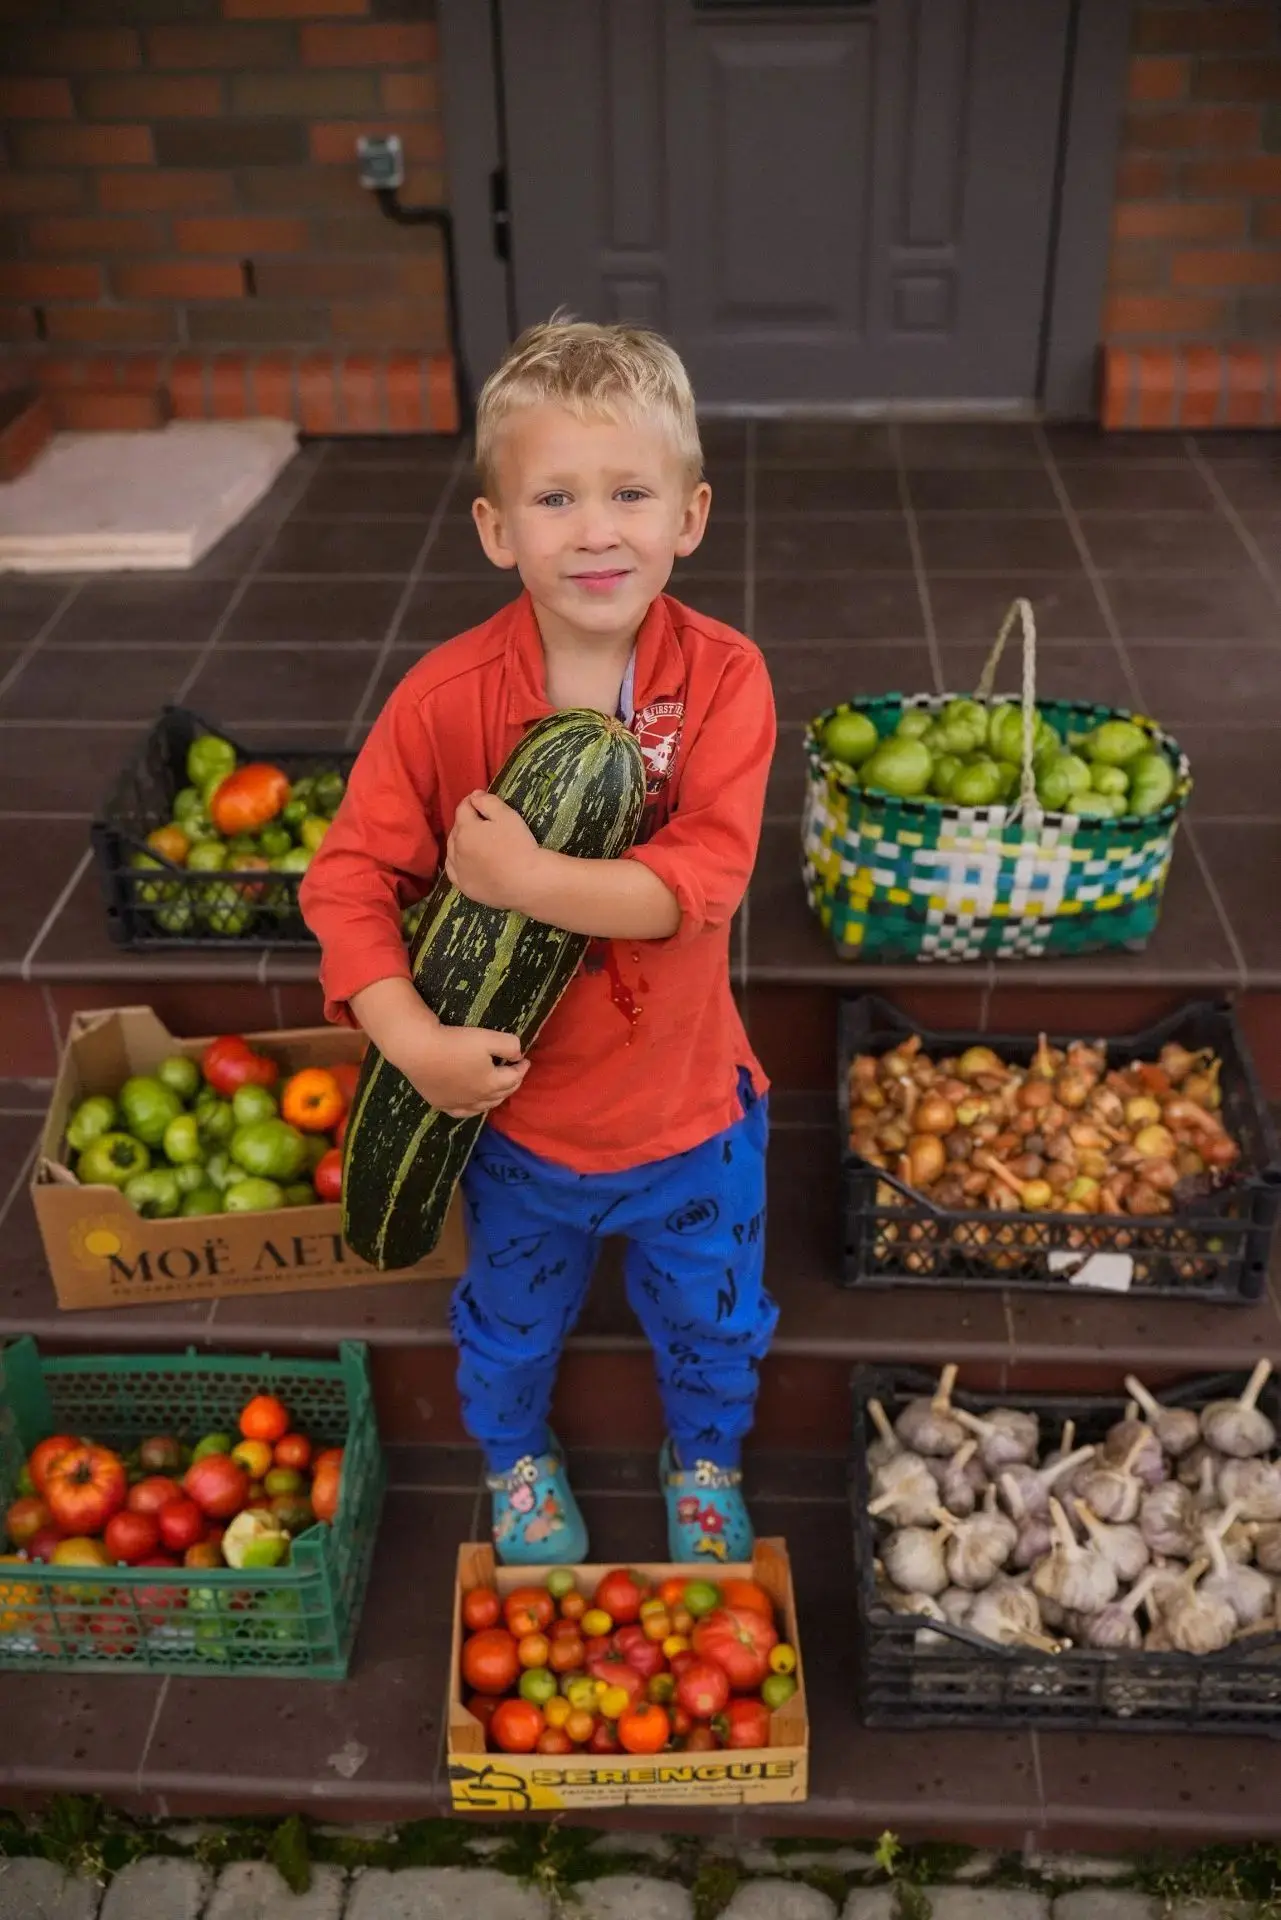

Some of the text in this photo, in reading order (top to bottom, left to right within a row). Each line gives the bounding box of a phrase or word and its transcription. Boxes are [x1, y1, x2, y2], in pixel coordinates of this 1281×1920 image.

[650, 705, 674, 717] FIRST
[107, 1237, 236, 1285] МОЁ
[253, 1233, 345, 1270] ЛЕТ
[532, 1760, 794, 1787] SERENGUE
